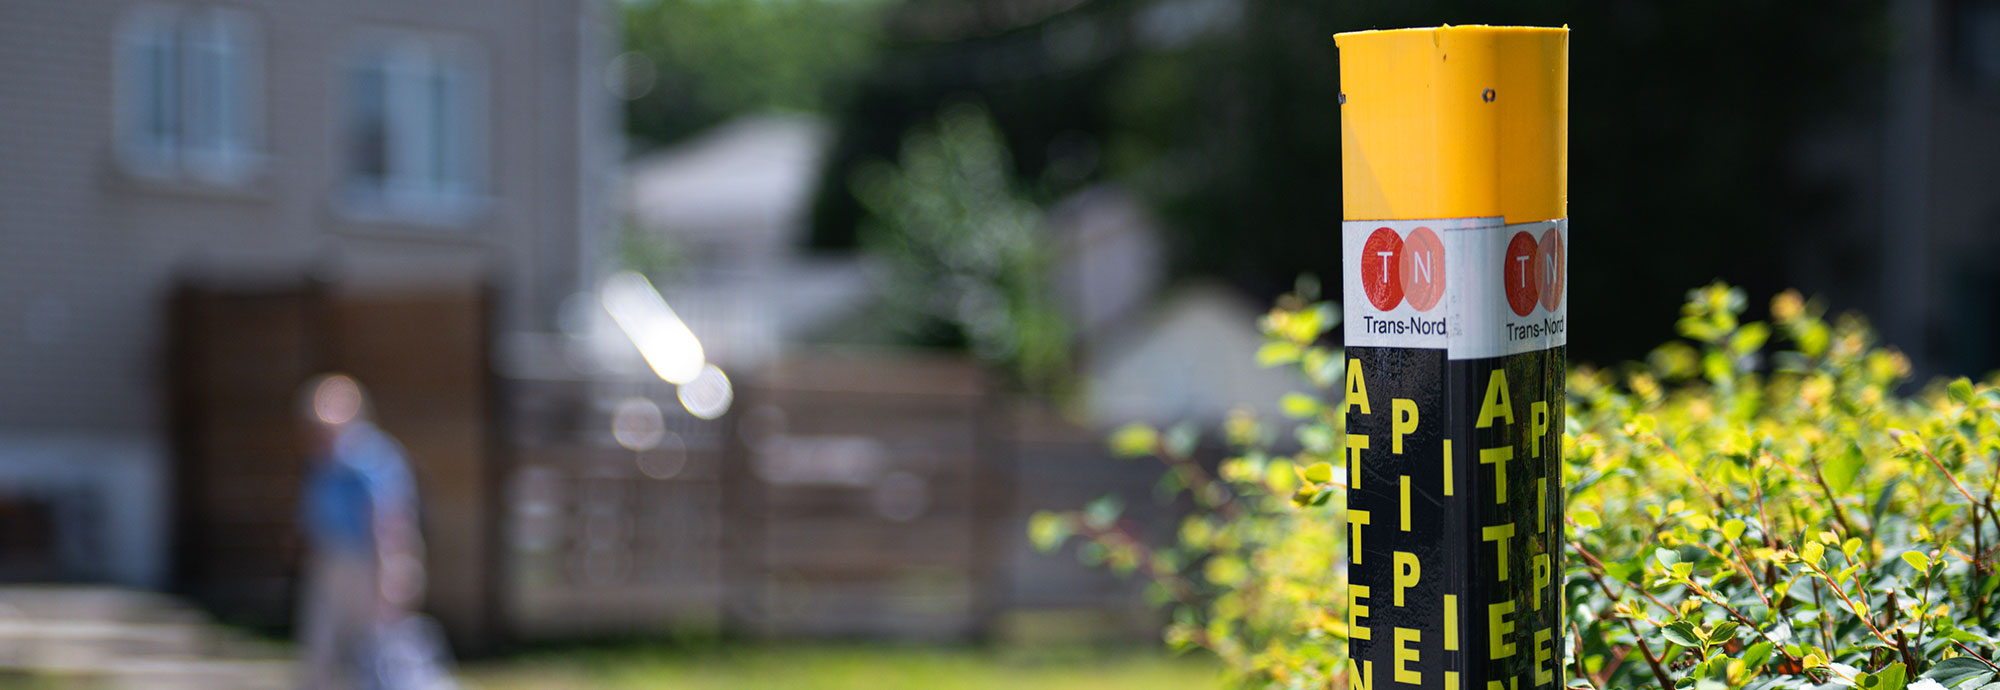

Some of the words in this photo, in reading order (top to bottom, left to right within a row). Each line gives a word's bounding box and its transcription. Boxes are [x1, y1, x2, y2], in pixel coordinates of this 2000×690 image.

[1363, 316, 1447, 336] Trans-Nord
[1506, 317, 1564, 341] Trans-Nord
[1392, 398, 1422, 686] PIPE
[1475, 368, 1519, 690] ATTE
[1531, 400, 1553, 687] PIPE
